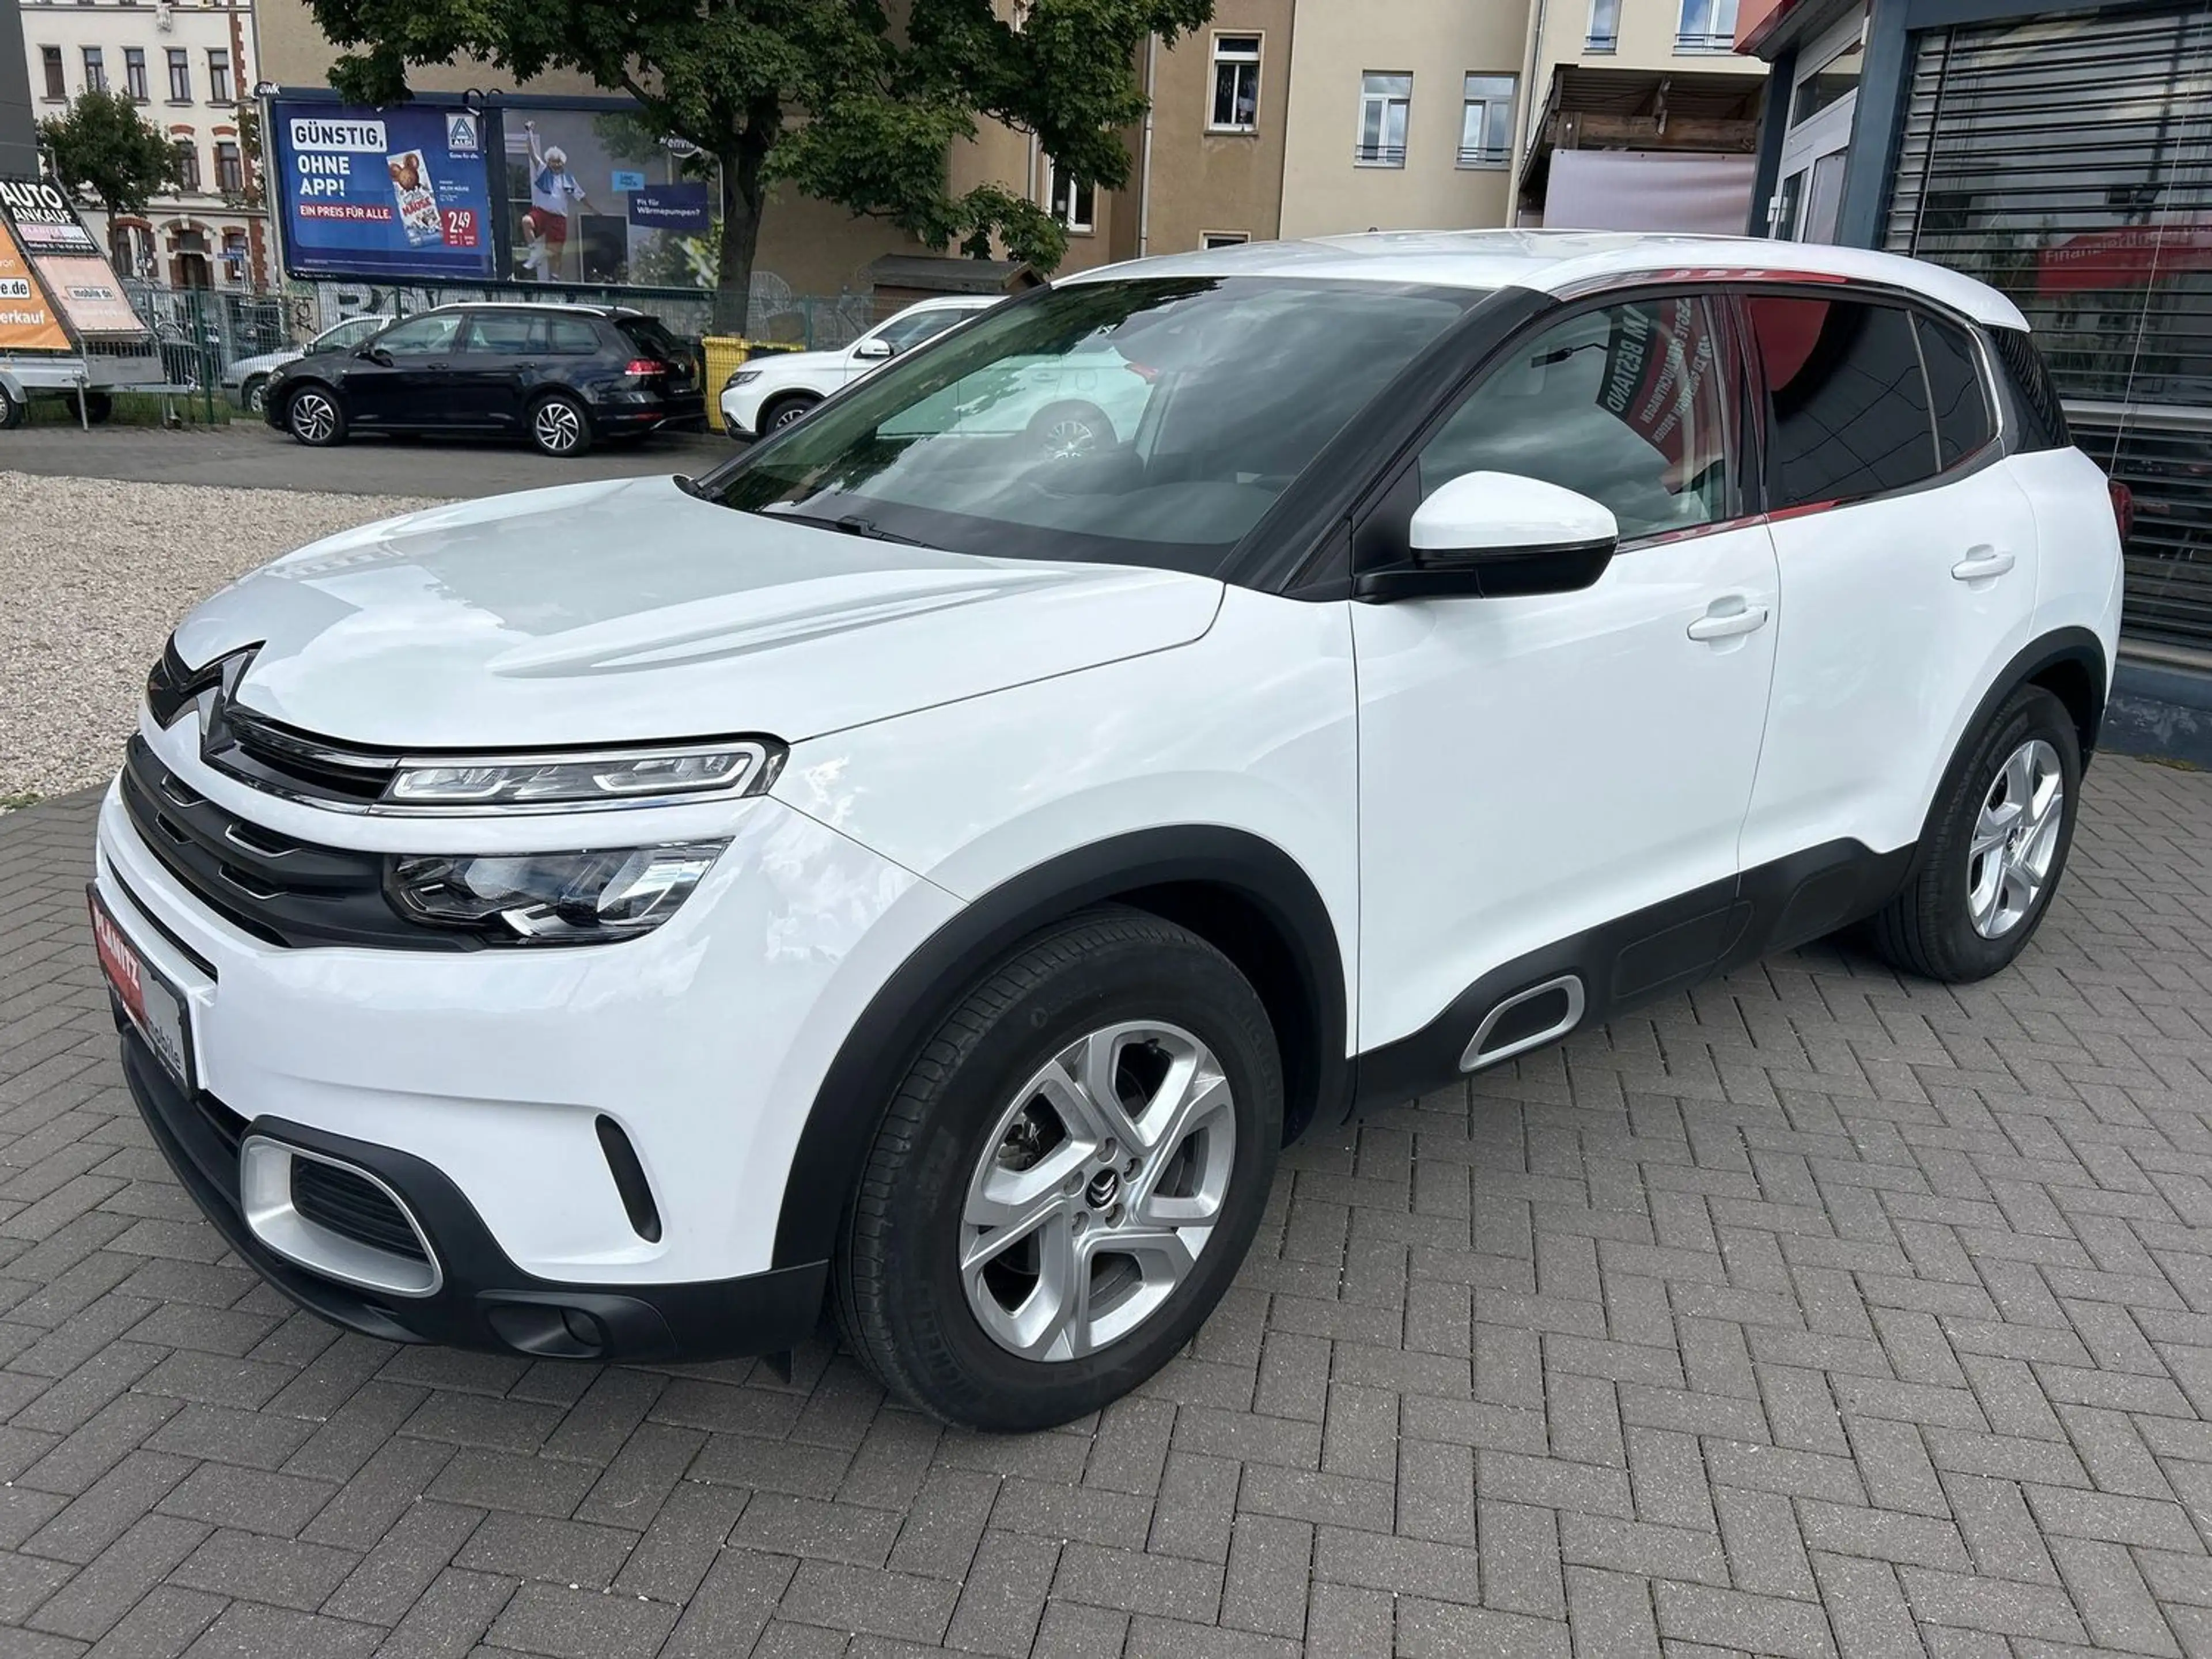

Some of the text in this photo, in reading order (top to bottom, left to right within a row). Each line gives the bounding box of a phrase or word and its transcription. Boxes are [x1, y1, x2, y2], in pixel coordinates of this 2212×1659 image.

[295, 121, 383, 148] GÜNSTIG,
[297, 154, 350, 175] OHNE
[1, 182, 63, 209] AUTO
[299, 177, 345, 196] APP!
[12, 207, 72, 224] ANKAUF
[299, 204, 392, 219] EIN PREIS FÜR ALLE.
